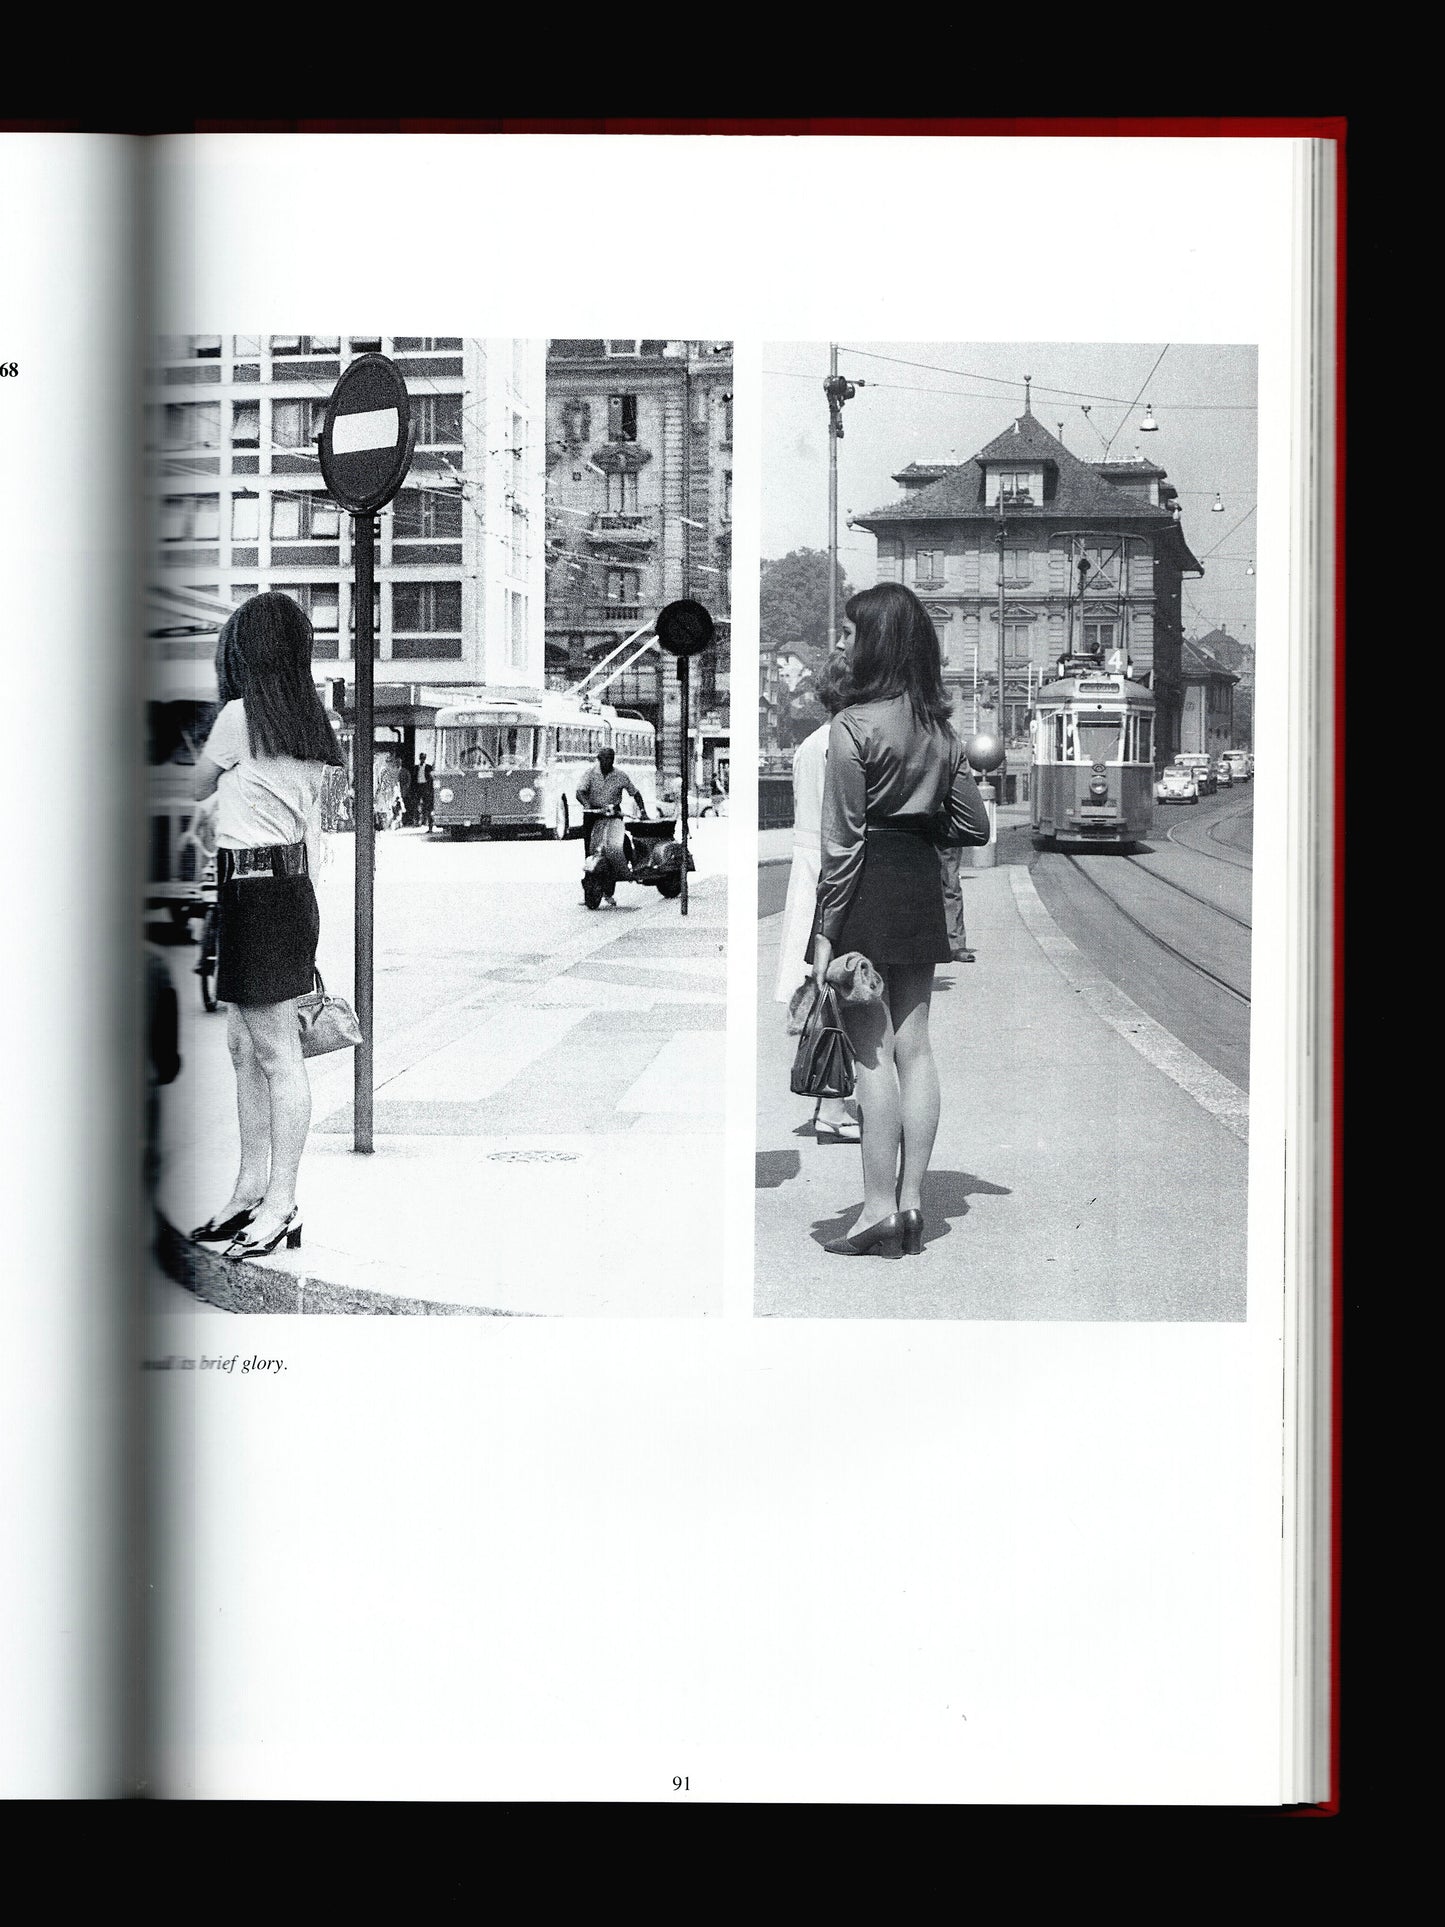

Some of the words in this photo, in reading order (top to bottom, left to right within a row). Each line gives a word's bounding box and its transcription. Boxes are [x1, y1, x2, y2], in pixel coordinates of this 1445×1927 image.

[1107, 650, 1123, 673] 4
[200, 1355, 239, 1374] brief
[241, 1355, 288, 1374] glory.
[672, 1776, 690, 1791] 91
